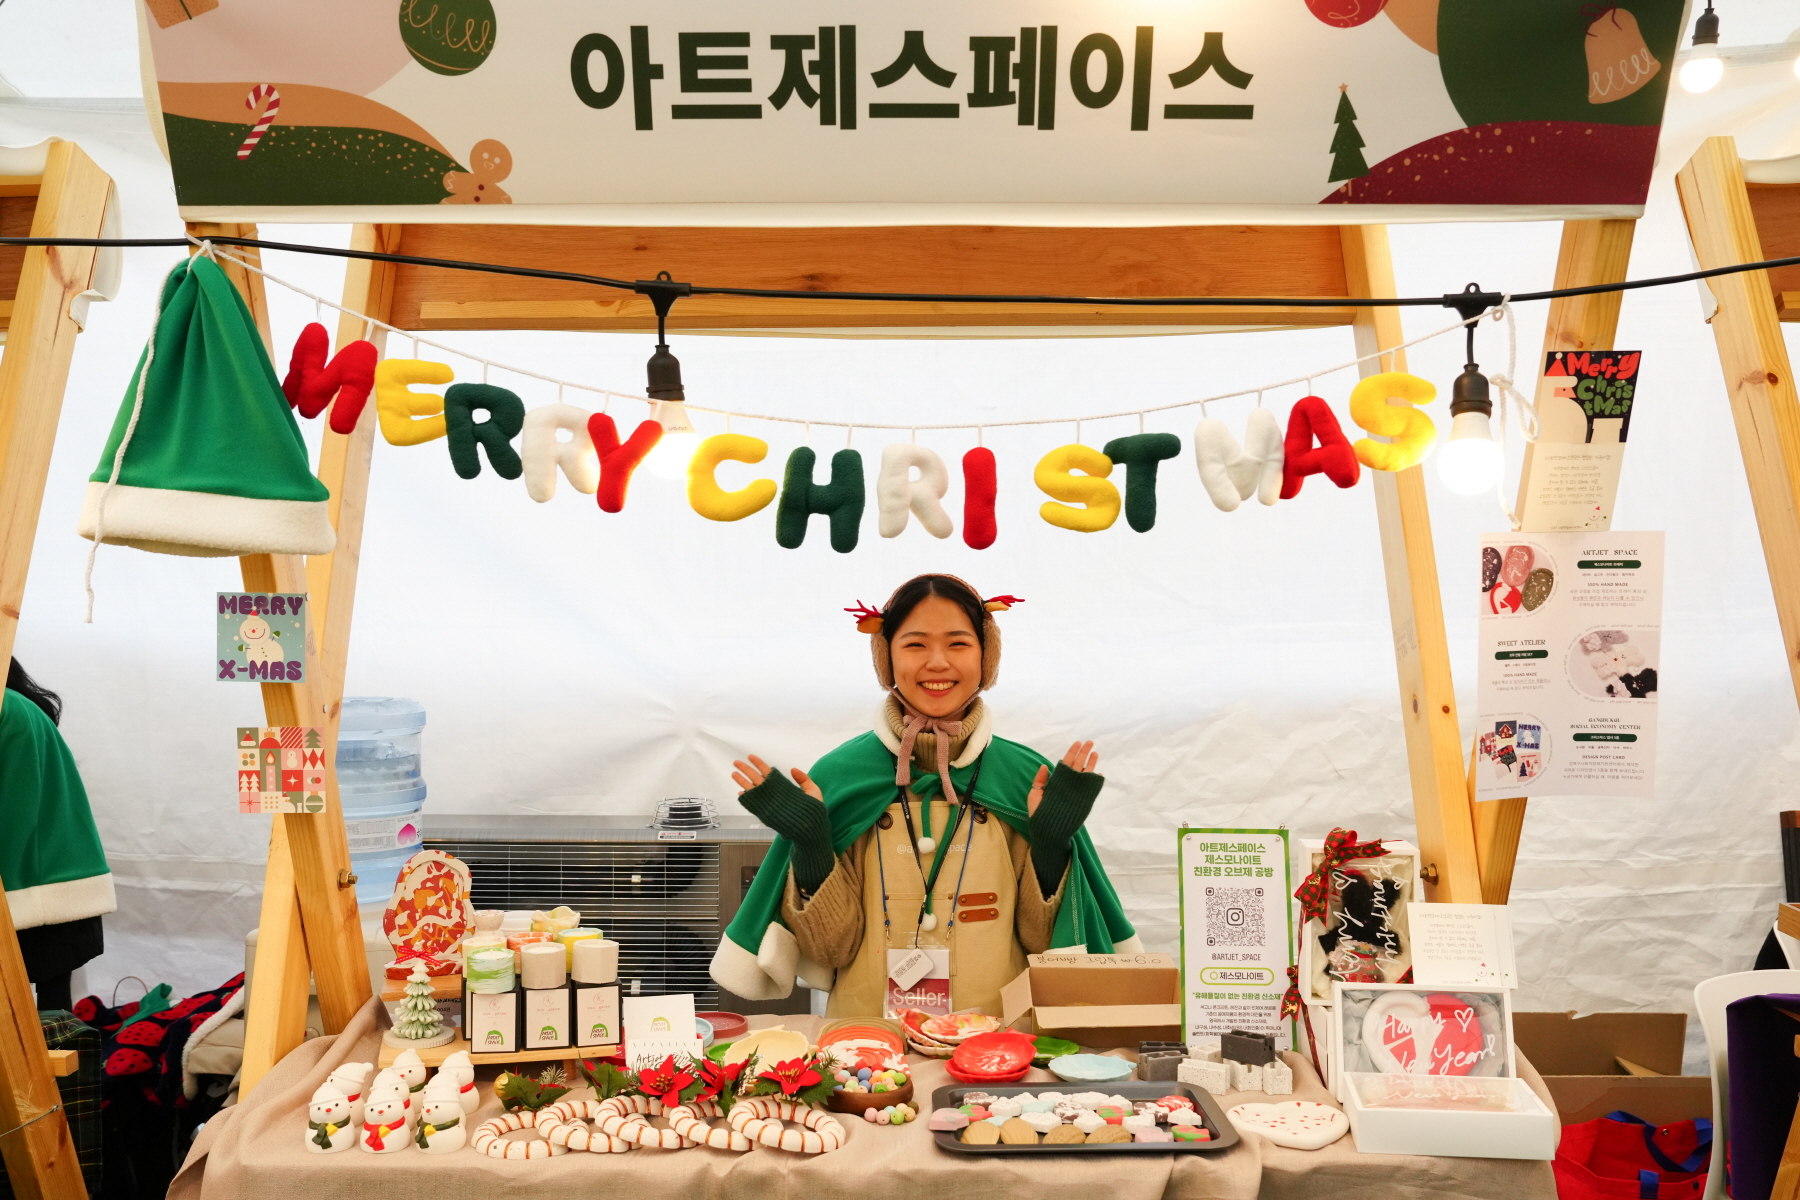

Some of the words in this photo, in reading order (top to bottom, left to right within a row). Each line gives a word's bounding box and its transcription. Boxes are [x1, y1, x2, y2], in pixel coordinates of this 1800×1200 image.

[570, 24, 1255, 131] 아트제스페이스
[1566, 352, 1640, 380] Merry
[282, 322, 664, 514] MERRY
[218, 595, 303, 616] MERRY
[218, 659, 302, 681] X-MAS
[1200, 842, 1266, 853] 아트제스페이스
[1205, 854, 1262, 865] 제스모나이트
[1194, 866, 1221, 877] 친환경
[1224, 867, 1252, 877] 오브제
[1255, 867, 1274, 877] 공방
[1036, 955, 1078, 964] 붕어빵
[1084, 956, 1116, 965] 그립톡
[1212, 953, 1261, 961] @ARTJET_SPACE
[1220, 972, 1264, 980] 제스모나이트
[892, 988, 946, 1006] Seller
